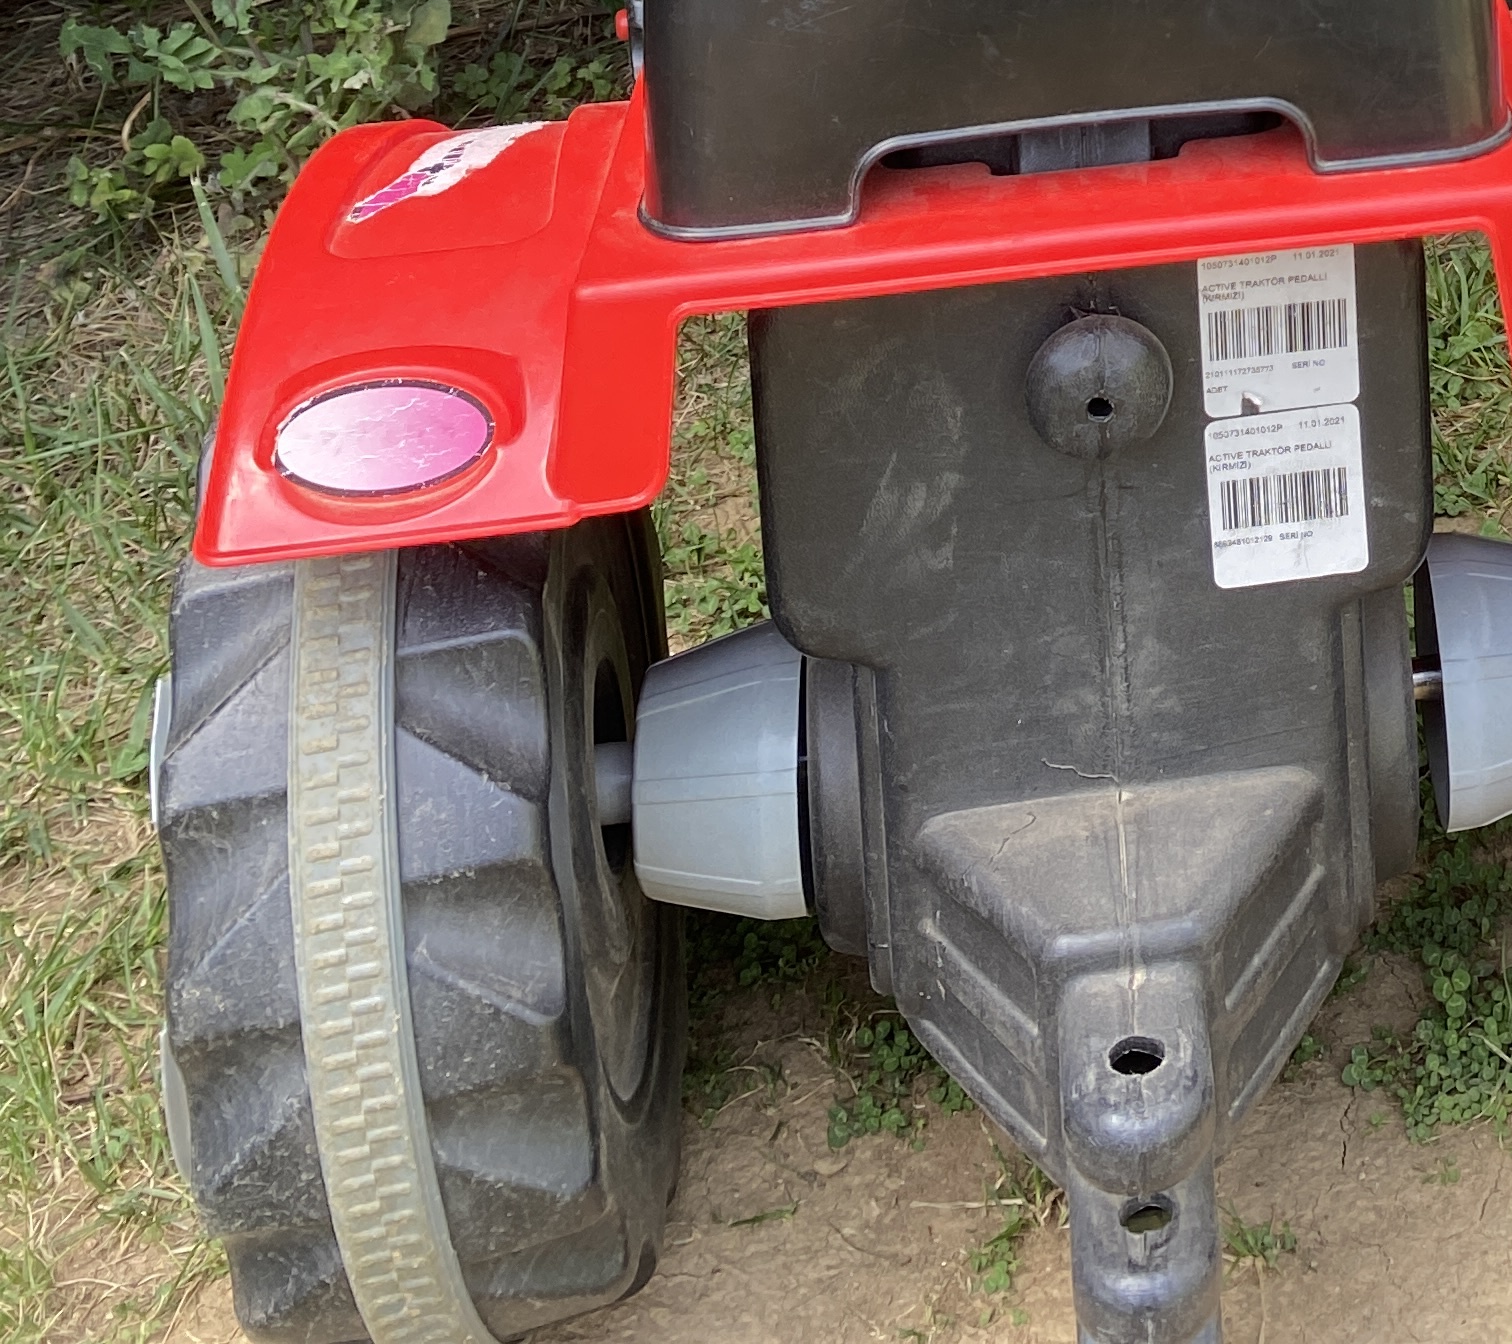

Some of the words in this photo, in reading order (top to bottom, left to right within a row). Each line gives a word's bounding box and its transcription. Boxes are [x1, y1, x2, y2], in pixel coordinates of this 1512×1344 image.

[1201, 281, 1237, 293] ACTIVE
[1312, 358, 1326, 368] NO
[1298, 415, 1345, 430] 11.01.2021
[1208, 451, 1244, 463] ACTIVE
